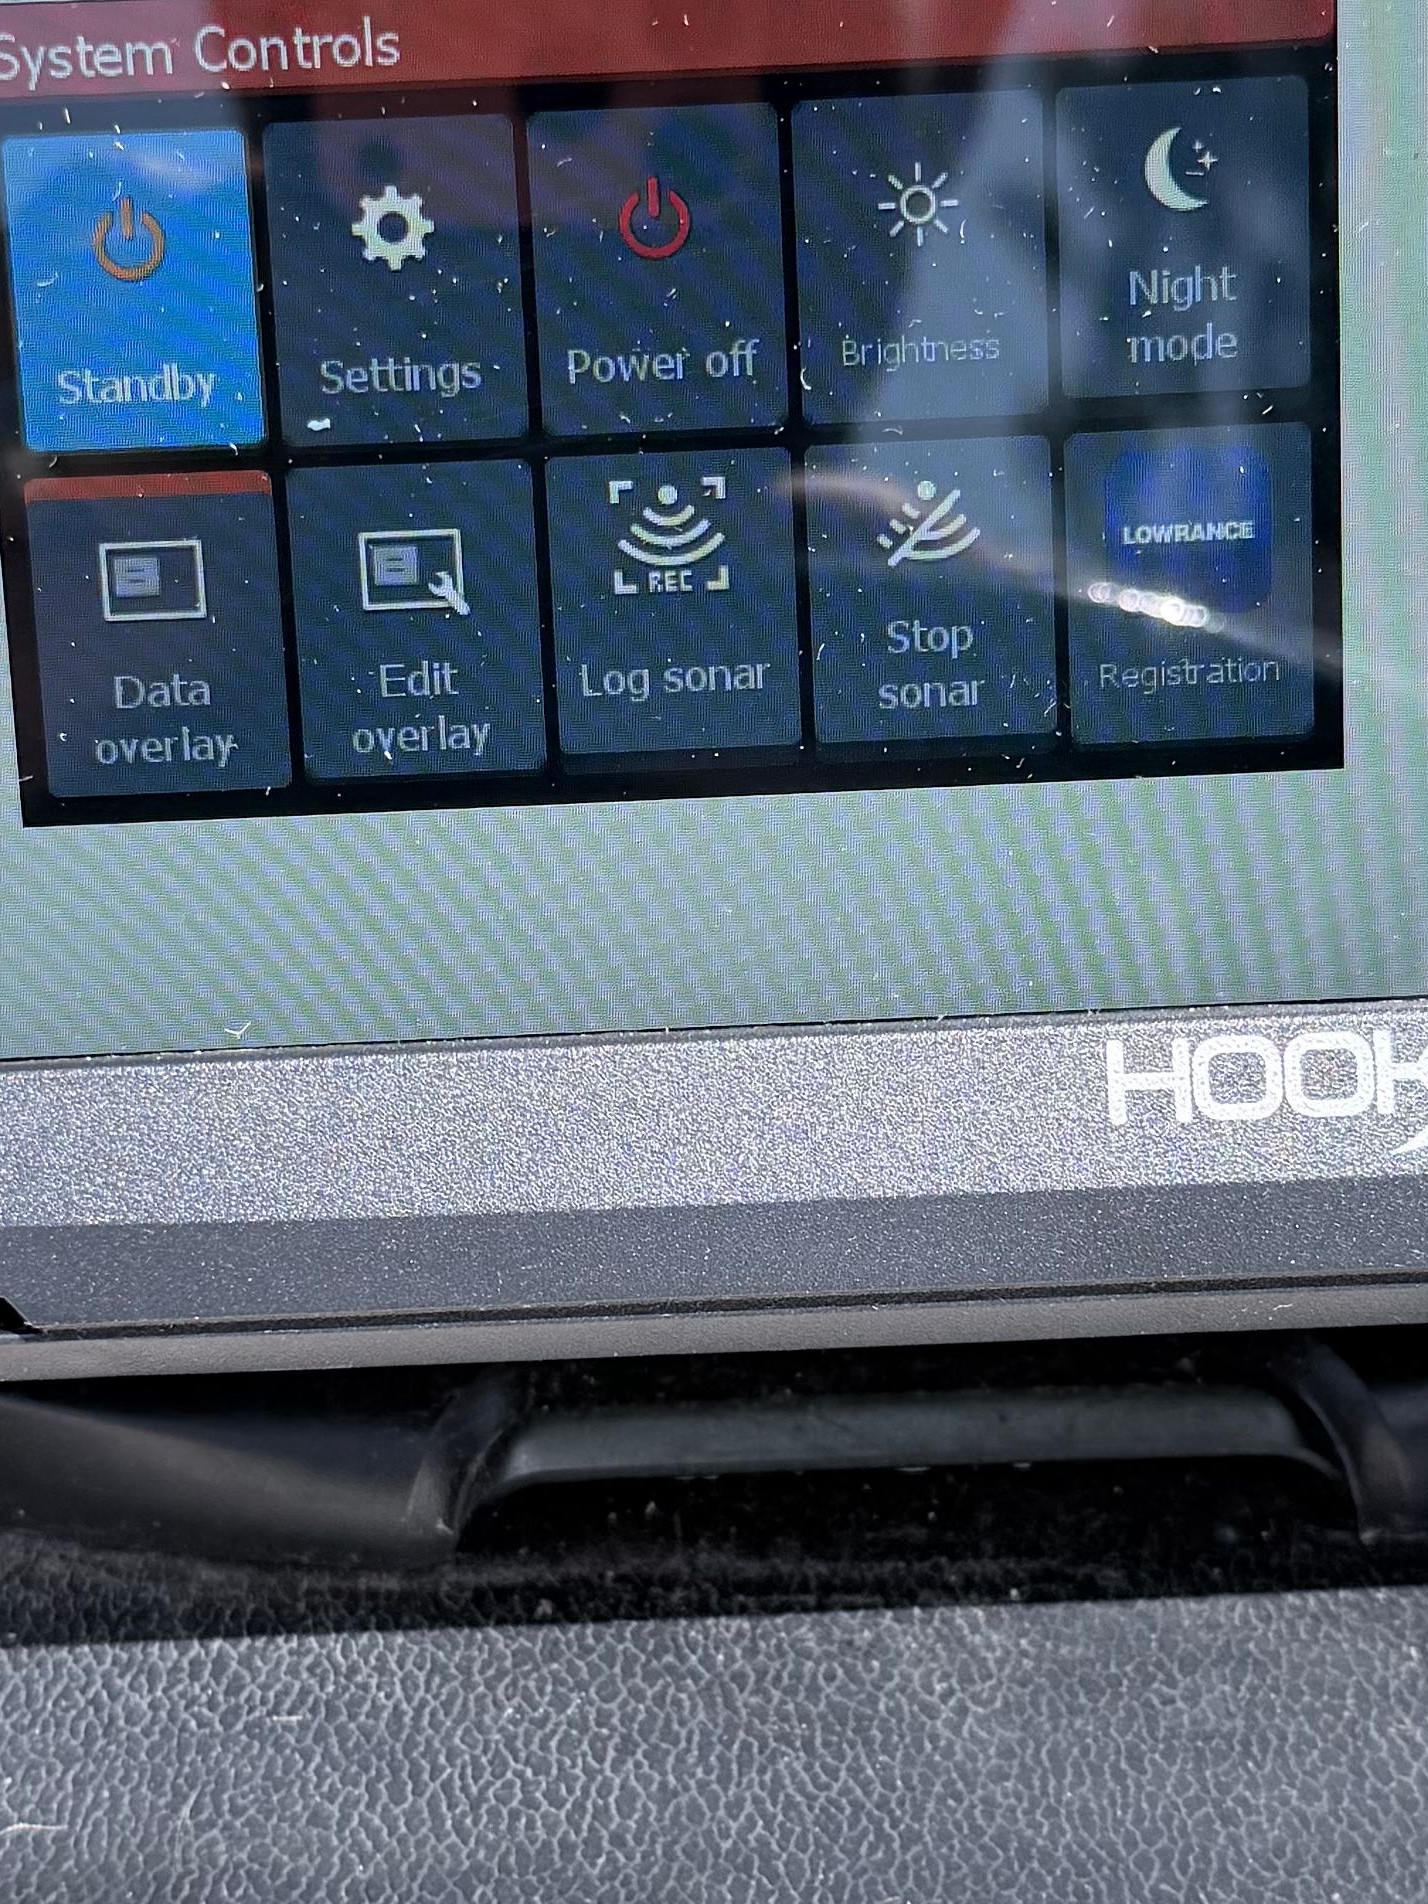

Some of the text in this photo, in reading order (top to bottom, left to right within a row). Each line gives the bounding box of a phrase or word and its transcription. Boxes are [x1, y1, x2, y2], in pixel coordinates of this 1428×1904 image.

[194, 16, 401, 75] Controls
[1128, 263, 1239, 312] Night
[566, 339, 759, 385] Power off
[841, 334, 1000, 373] Brightness
[1128, 322, 1240, 364] mode
[56, 362, 217, 409] Standby
[320, 356, 483, 400] Settings
[1121, 519, 1256, 546] LOWRANCE
[647, 569, 694, 594] REC
[886, 619, 974, 660] Stop
[113, 673, 211, 711] Data
[378, 660, 459, 698] Edit
[581, 658, 772, 704] Log sonar
[877, 677, 985, 709] sonar
[1098, 657, 1280, 694] Registration
[94, 725, 235, 769] overlay
[352, 715, 491, 760] overlay
